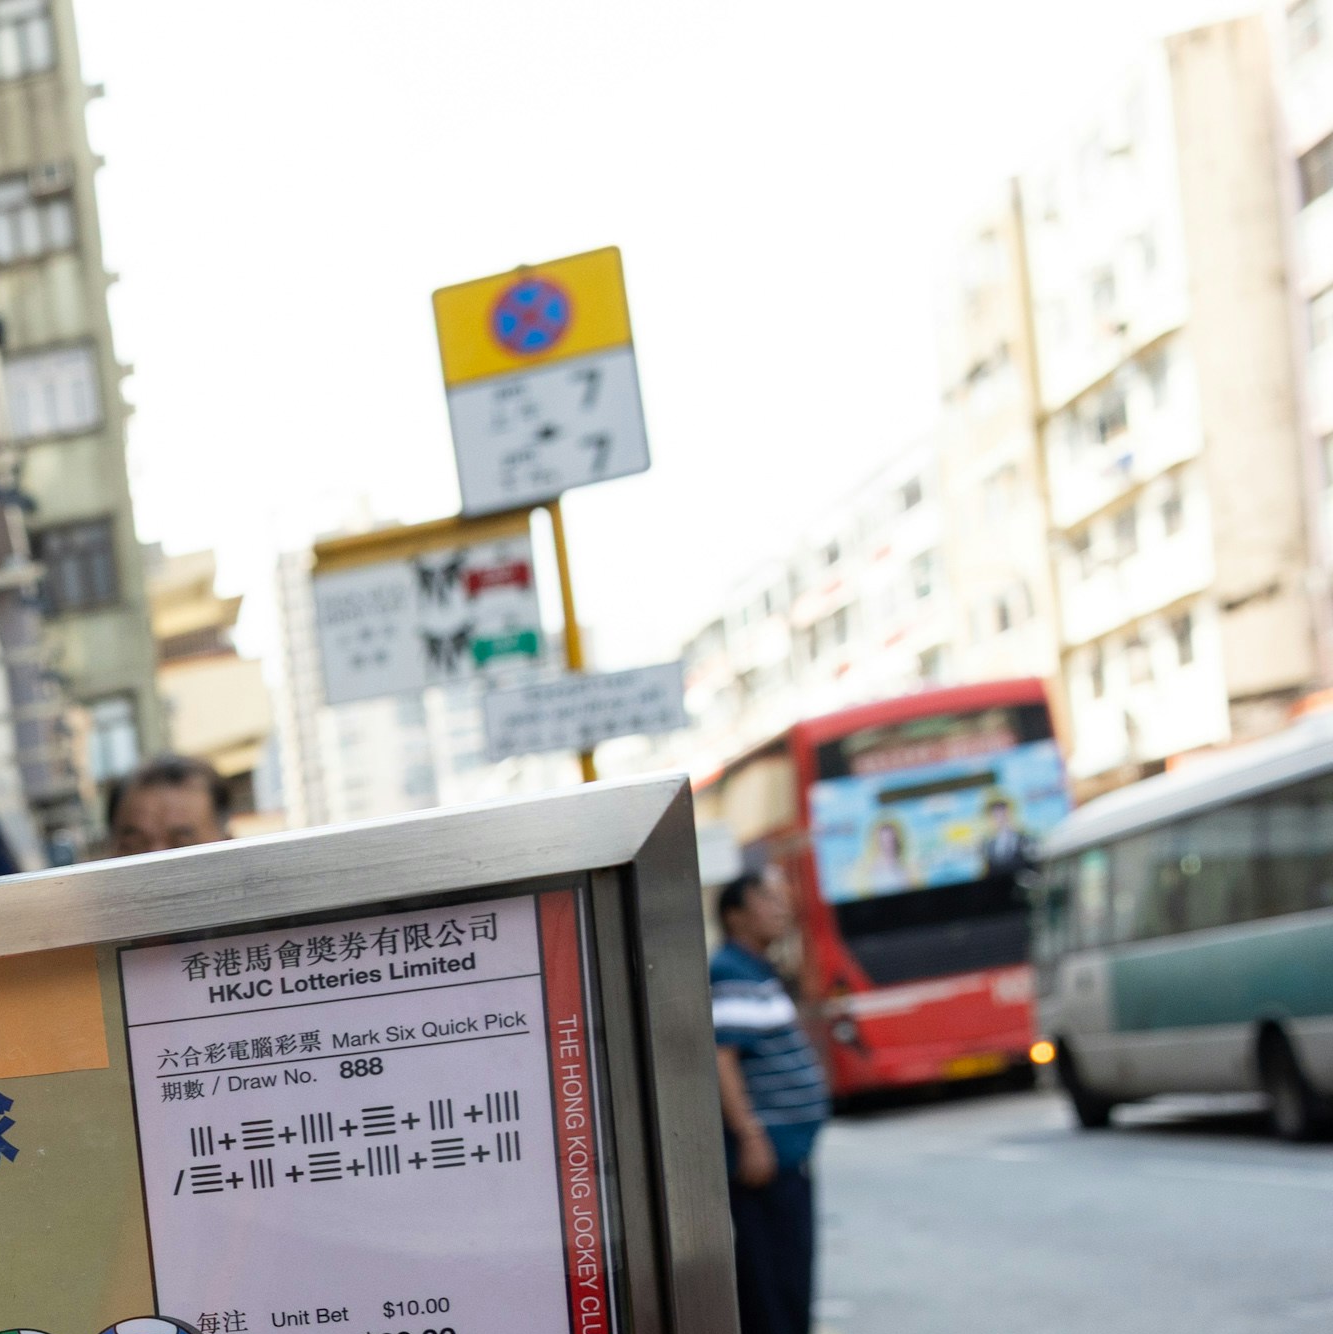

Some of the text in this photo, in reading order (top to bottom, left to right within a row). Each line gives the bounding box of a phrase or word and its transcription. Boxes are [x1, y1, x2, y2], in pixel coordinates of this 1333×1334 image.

[181, 912, 498, 981] 香港馬會獎券有限公司
[209, 953, 476, 1003] HKJC Lotteries Limited
[156, 1011, 526, 1070] 六合彩電腦彩票 Mark Six Quick Pick
[557, 1014, 579, 1057] THE
[160, 1078, 205, 1103] 期數
[228, 1072, 277, 1092] Draw
[284, 1069, 317, 1085] No.
[339, 1057, 384, 1079] 888
[561, 1064, 586, 1130] HONG
[567, 1135, 590, 1199] KONG
[572, 1205, 598, 1288] JOCKEY
[271, 1311, 311, 1328] Unit
[316, 1306, 349, 1324] Bet
[382, 1297, 450, 1319] $10.00
